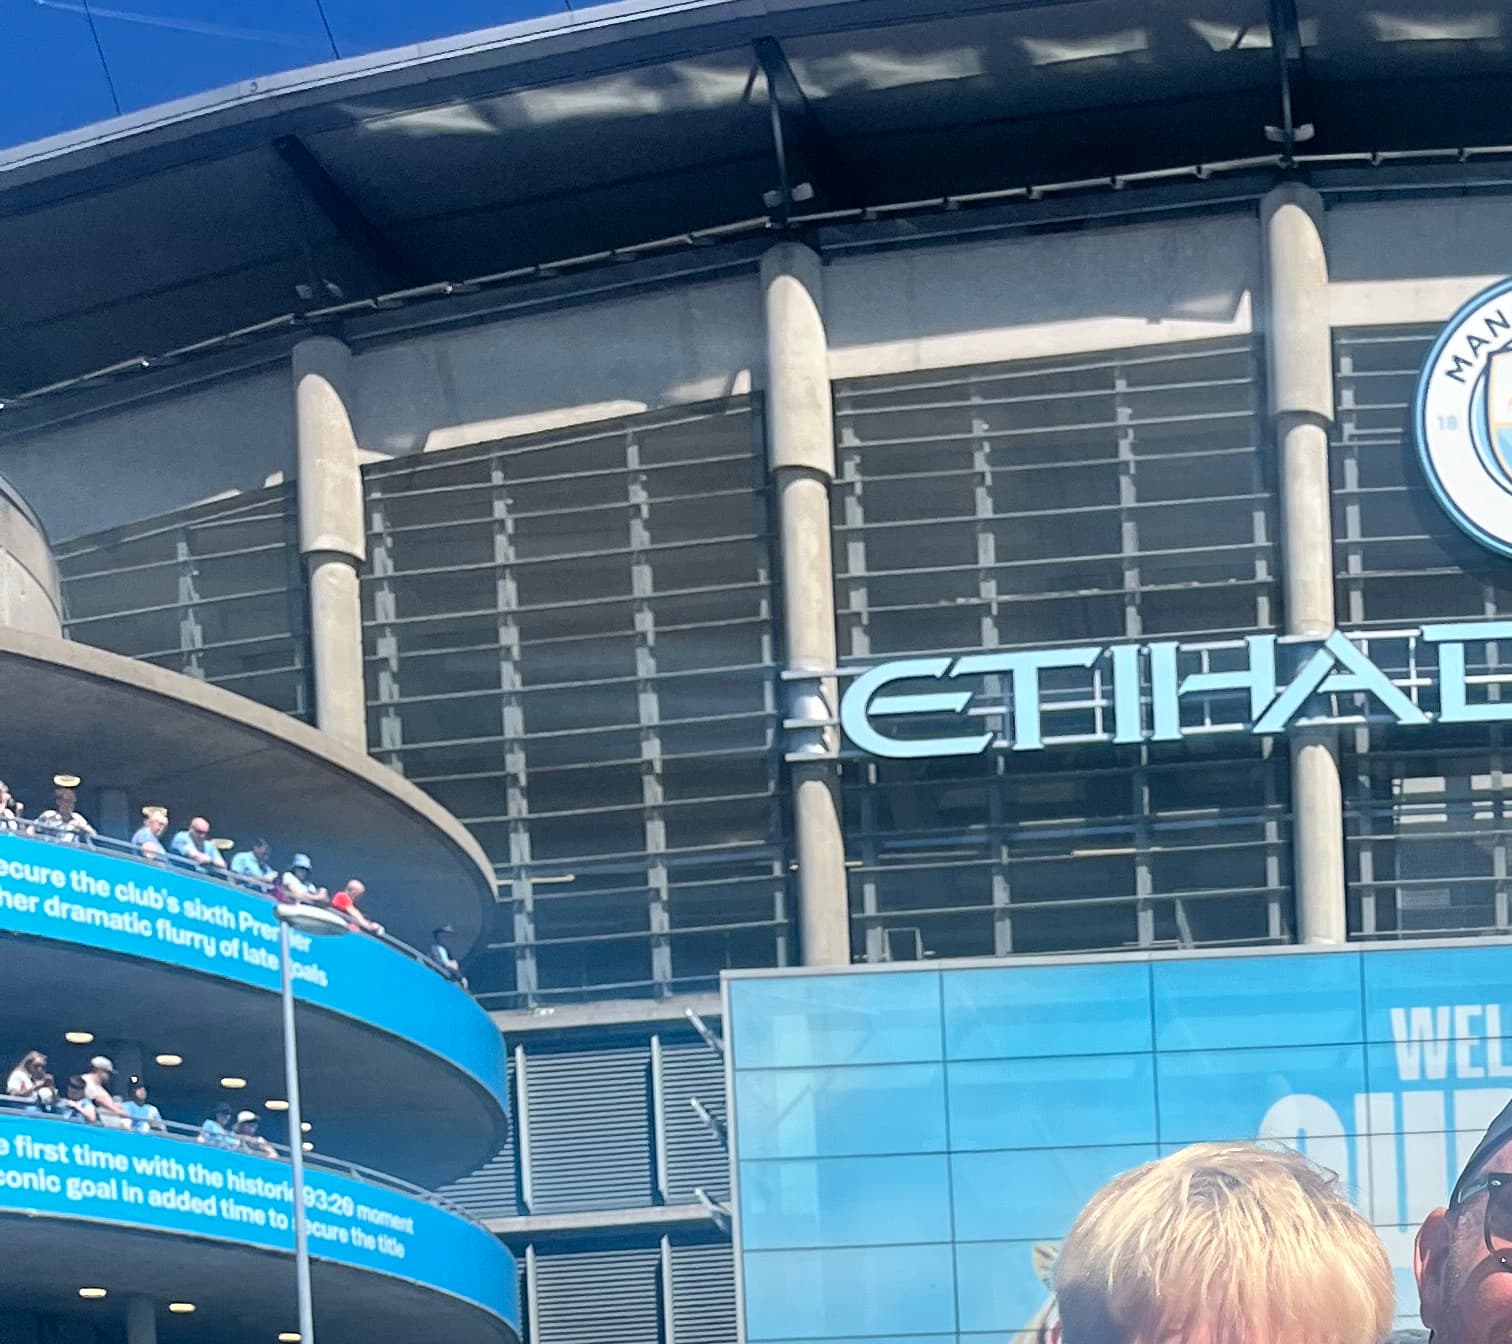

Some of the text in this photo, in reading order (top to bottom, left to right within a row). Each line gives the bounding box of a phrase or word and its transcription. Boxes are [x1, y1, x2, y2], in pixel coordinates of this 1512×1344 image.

[44, 896, 152, 937] dramatic
[156, 918, 216, 958] flurry
[219, 938, 241, 959] of
[243, 941, 279, 971] late
[288, 959, 329, 987] oals
[70, 869, 111, 897] the
[115, 881, 179, 914] club's
[184, 899, 236, 931] sixth
[14, 1134, 70, 1164] first
[72, 1143, 129, 1172] time
[132, 1154, 185, 1182] with
[188, 1162, 224, 1189] the
[356, 1203, 415, 1235] moment
[66, 1176, 118, 1201] goal
[122, 1178, 144, 1205] in
[148, 1187, 218, 1217] added
[219, 1197, 266, 1226] time
[268, 1208, 289, 1231] to
[351, 1226, 377, 1251] the
[378, 1232, 406, 1260] title
